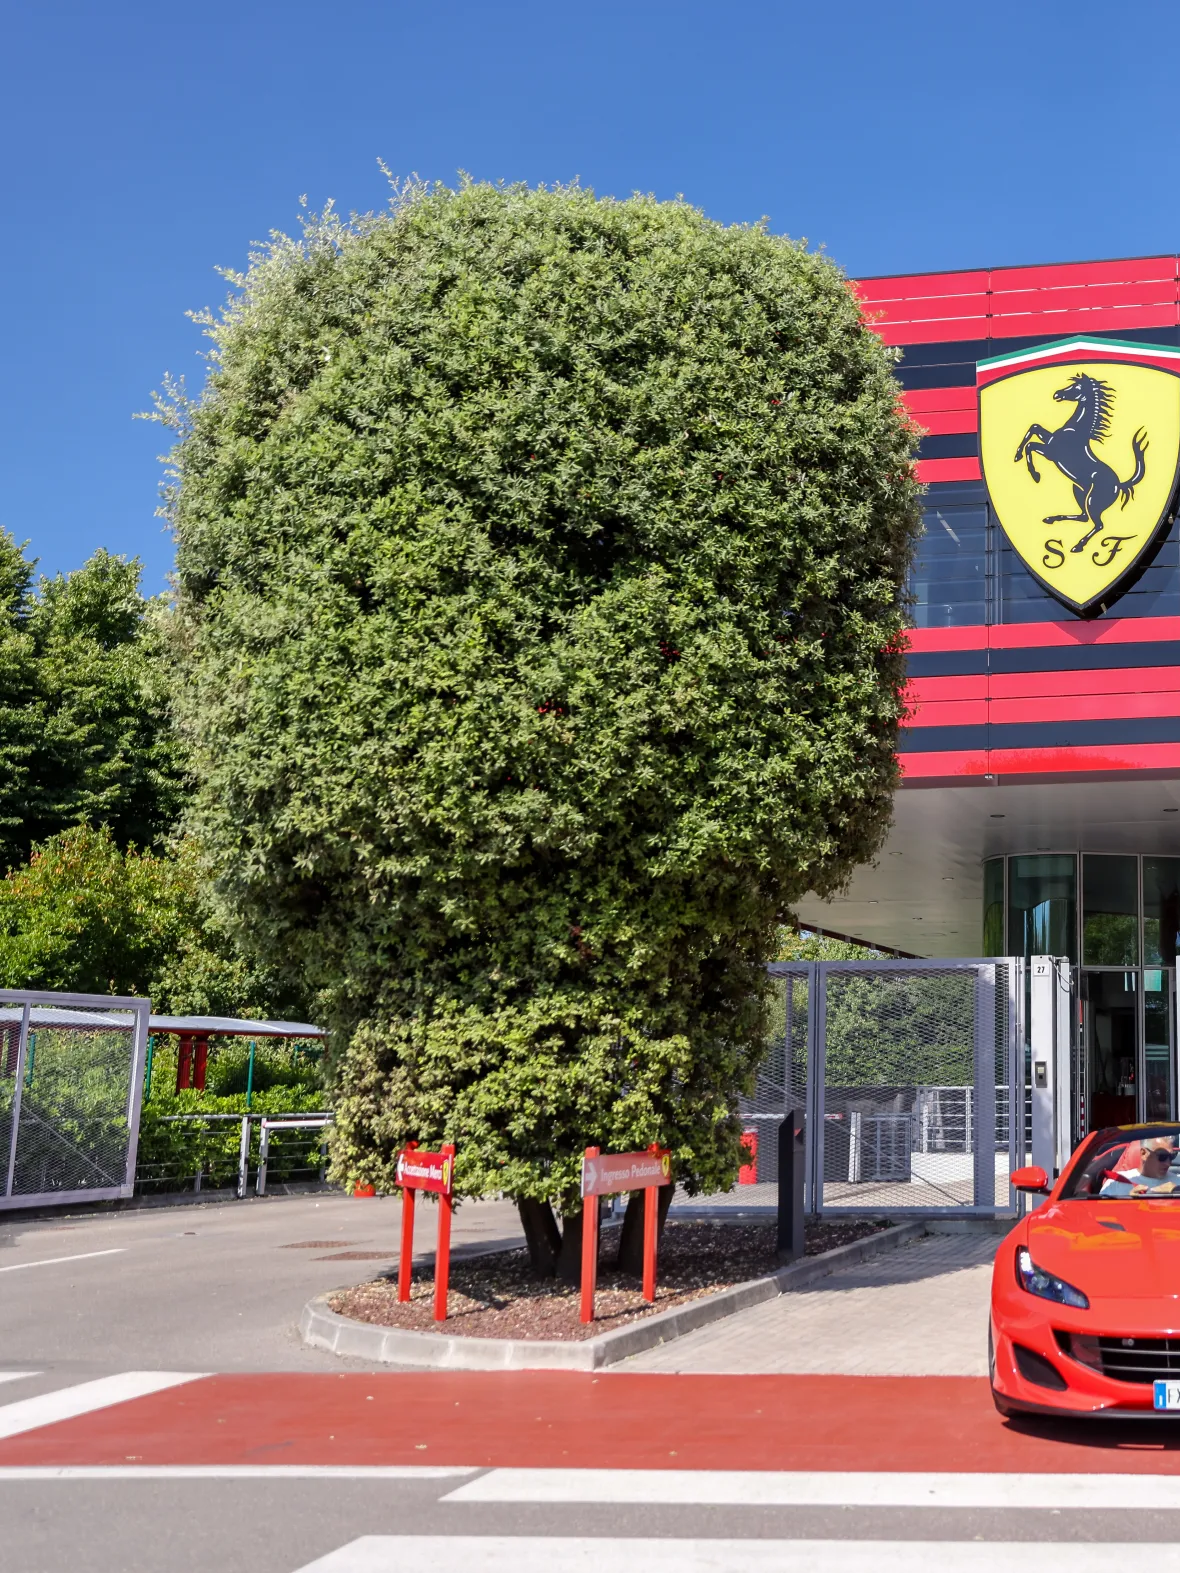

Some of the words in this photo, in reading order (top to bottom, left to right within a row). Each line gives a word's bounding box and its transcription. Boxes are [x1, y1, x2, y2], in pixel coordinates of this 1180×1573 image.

[1042, 539, 1065, 569] S
[1091, 534, 1138, 567] F
[1037, 966, 1045, 974] 27
[601, 1167, 630, 1186] Ingresso
[631, 1160, 661, 1178] Pedonale
